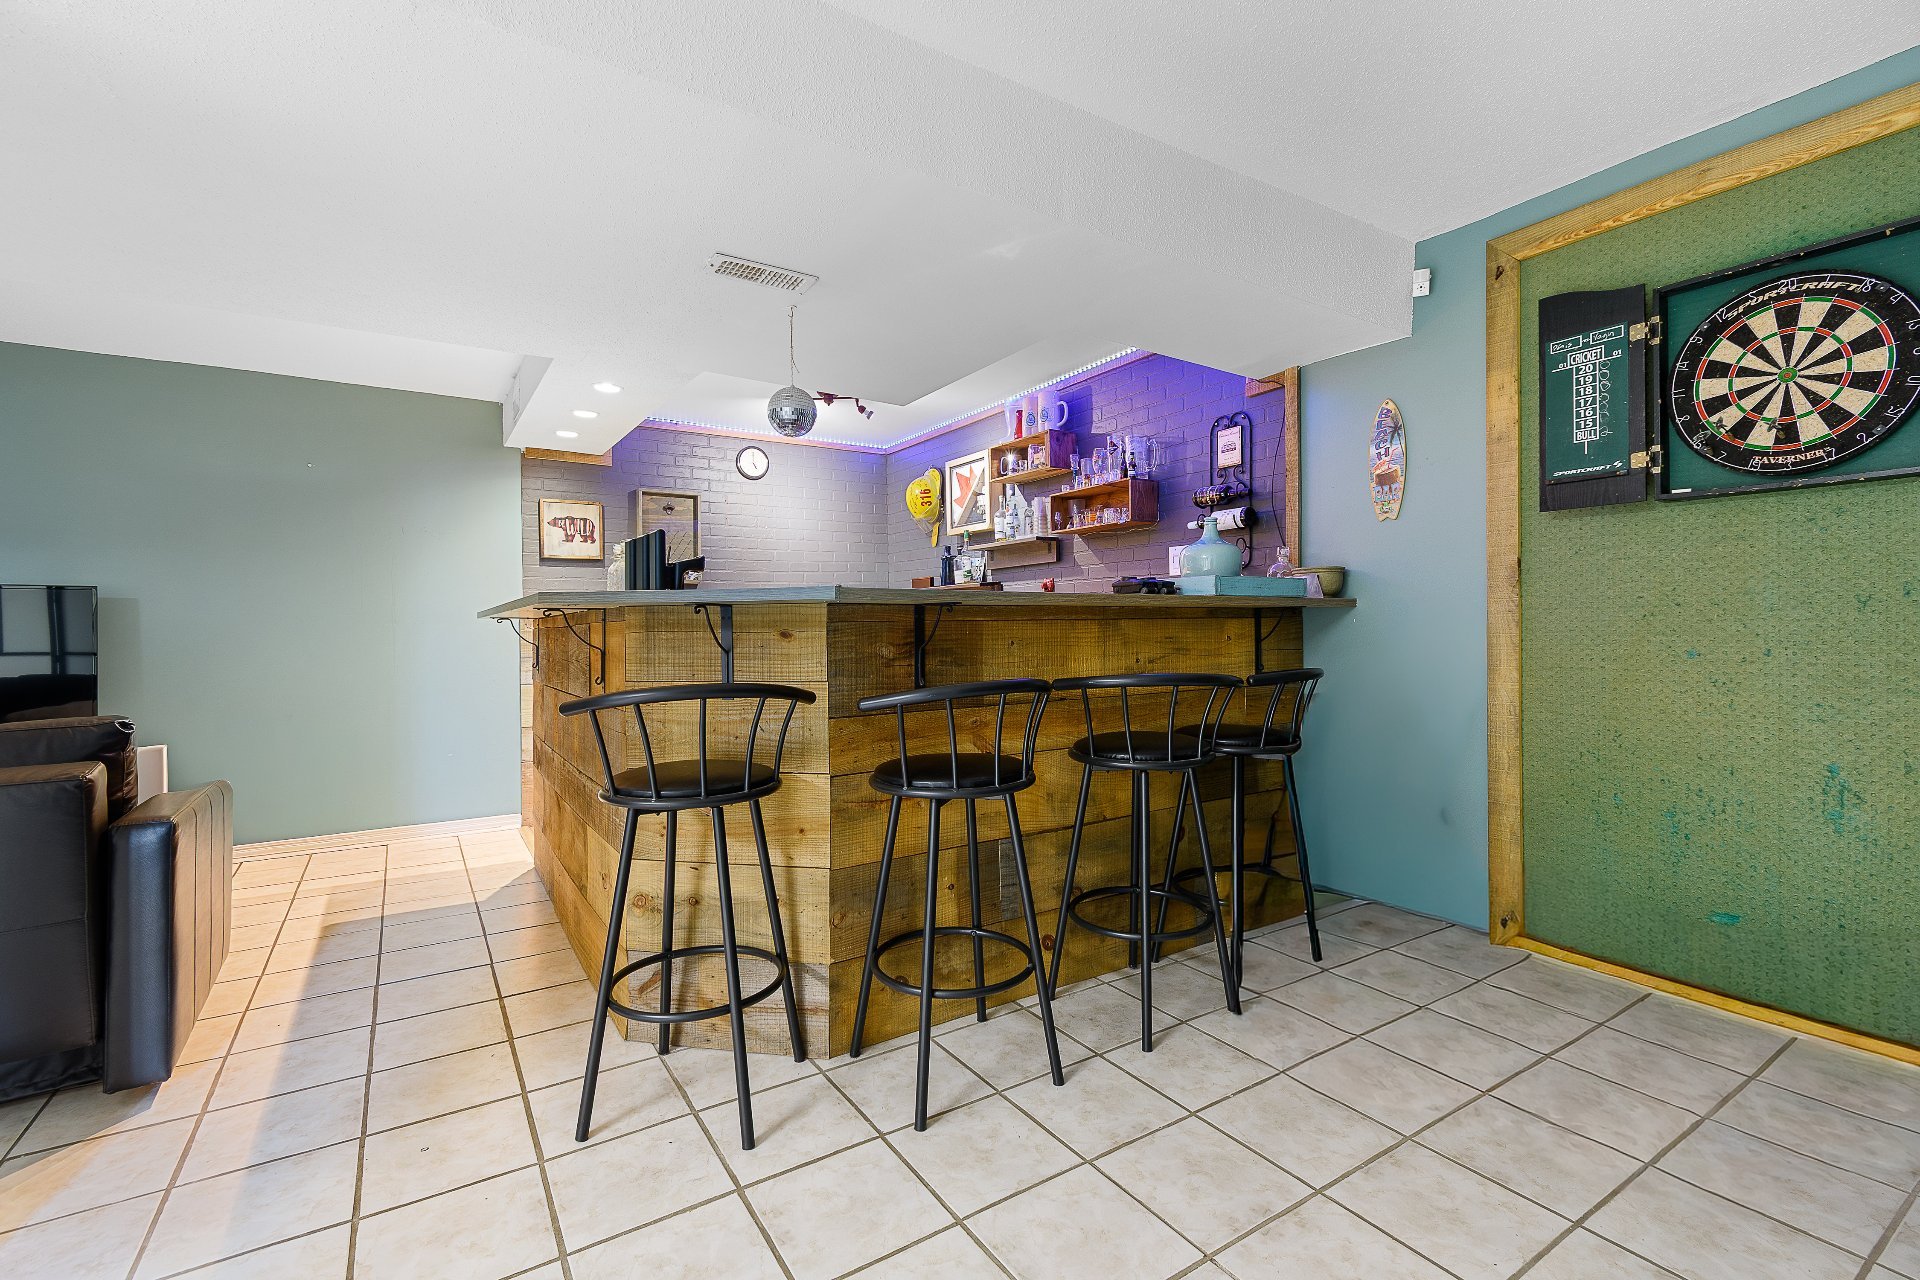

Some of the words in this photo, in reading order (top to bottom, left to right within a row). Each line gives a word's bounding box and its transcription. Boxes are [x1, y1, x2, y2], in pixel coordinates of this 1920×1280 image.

[1570, 348, 1602, 365] CRICKET
[1578, 363, 1594, 375] 20
[1578, 375, 1593, 386] 19
[1578, 386, 1593, 396] 18
[1578, 397, 1593, 408] 17
[1578, 408, 1594, 418] 16
[1578, 419, 1593, 429] 15
[1374, 406, 1392, 461] BEACH
[1576, 429, 1597, 441] BULL
[1752, 449, 1825, 464] TAVERNER
[1552, 464, 1613, 477] SPORTCRAFT
[919, 488, 933, 507] 316
[1373, 481, 1401, 503] BAR
